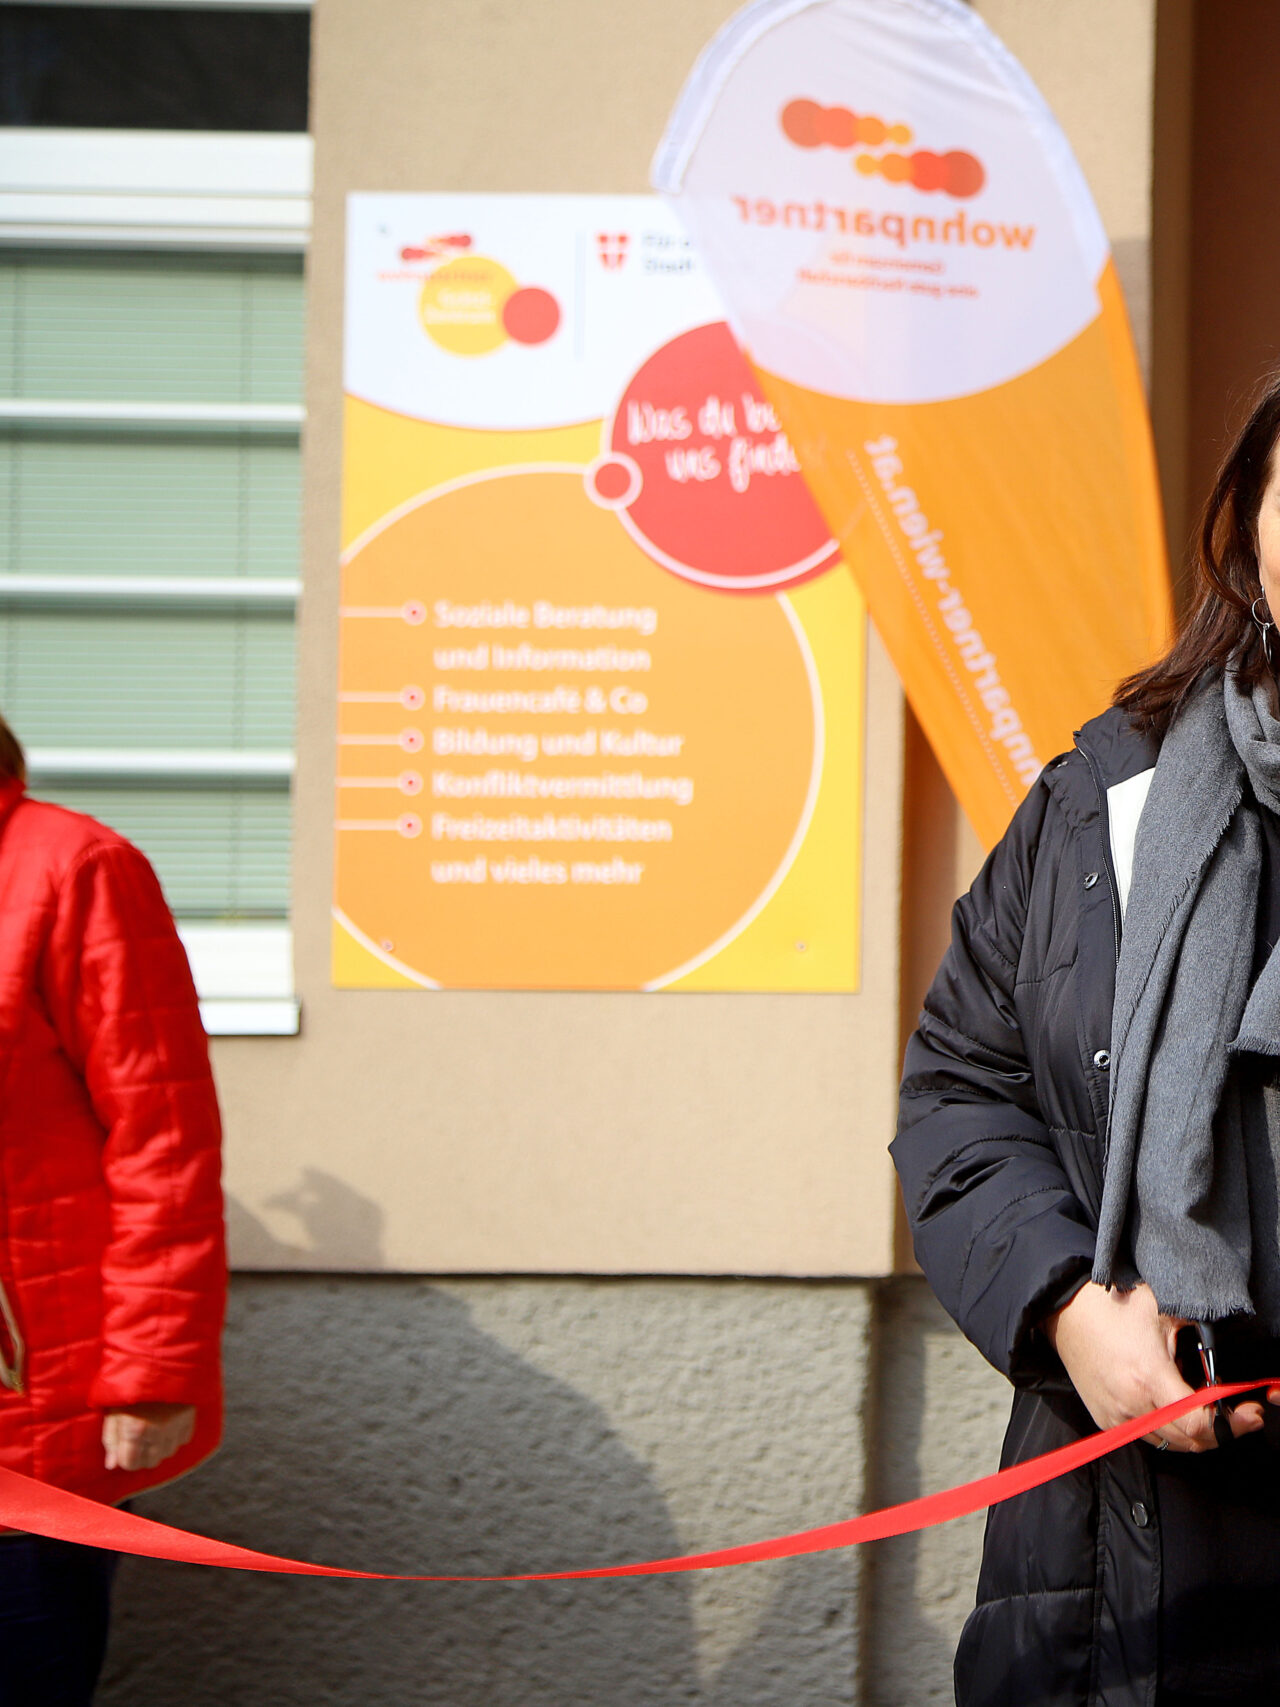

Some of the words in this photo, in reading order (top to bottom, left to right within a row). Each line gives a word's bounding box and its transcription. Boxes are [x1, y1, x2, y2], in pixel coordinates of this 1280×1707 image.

[433, 600, 529, 630] Soziale
[533, 601, 658, 635] Beratung
[433, 643, 489, 672] und
[492, 642, 652, 672] Information
[433, 685, 581, 715] Frauencafé
[585, 687, 607, 714] &
[610, 687, 648, 714] Co
[432, 728, 539, 762] Bildung
[542, 729, 597, 757] und
[600, 729, 684, 757] Kultur
[431, 770, 695, 805] Konfliktvermittlung
[431, 812, 673, 843] Freizeitaktivitäten
[430, 856, 487, 885] und
[490, 856, 568, 885] vieles
[571, 857, 644, 885] mehr
